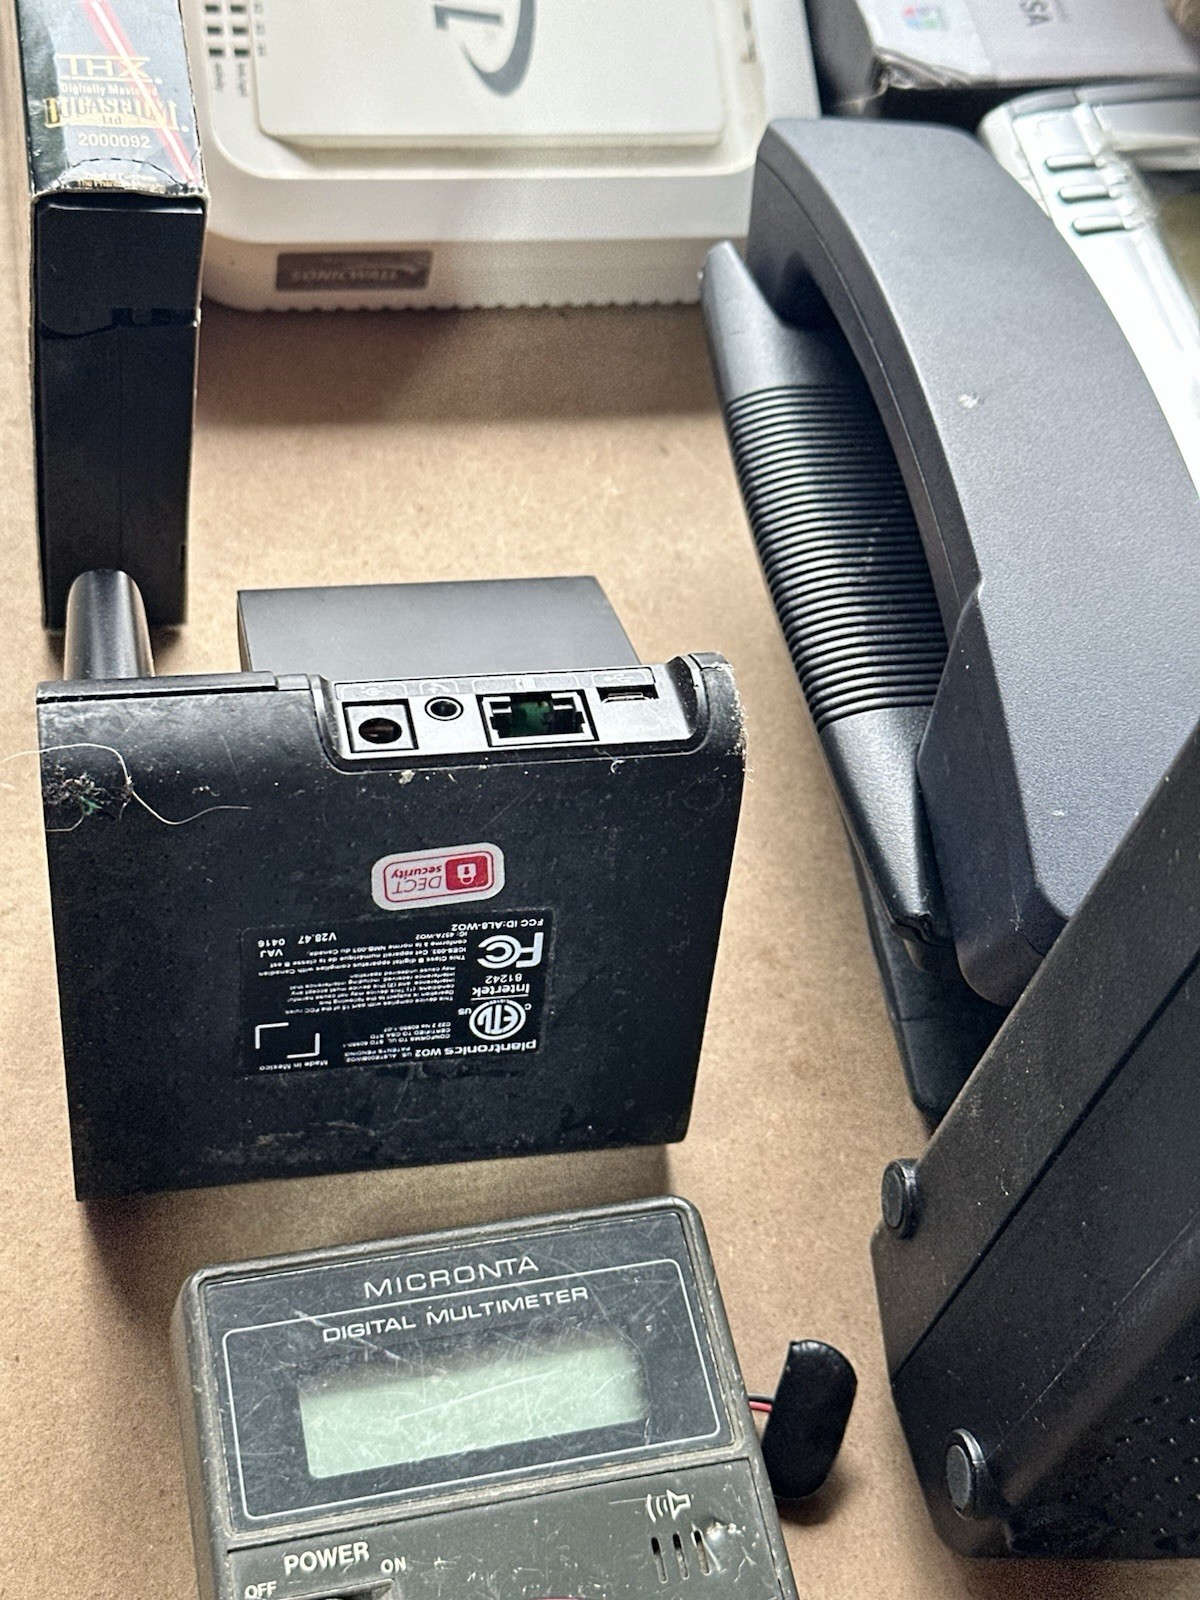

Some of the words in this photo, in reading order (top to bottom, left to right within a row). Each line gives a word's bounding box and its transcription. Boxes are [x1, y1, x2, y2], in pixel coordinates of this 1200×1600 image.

[56, 53, 152, 83] THX
[61, 83, 106, 98] Digitally
[77, 133, 152, 149] 2000092
[390, 866, 442, 880] security
[392, 876, 442, 894] DECT
[520, 918, 544, 927] FCC
[258, 938, 286, 948] 0416
[297, 932, 337, 944] V28.47
[430, 938, 467, 947] conforme
[388, 942, 413, 951] norme
[259, 948, 283, 958] VAJ
[382, 950, 414, 960] appareil
[315, 962, 351, 972] complies
[352, 960, 391, 969] apparatus
[392, 958, 416, 966] digital
[258, 968, 296, 976] Canadian
[484, 972, 522, 984] 81242
[420, 989, 454, 997] Operation
[472, 983, 530, 998] Intertek
[457, 1007, 472, 1016] US
[444, 1039, 537, 1056] plantronics
[304, 1060, 328, 1068] Made
[363, 1255, 539, 1299] MICRONTA
[322, 1315, 417, 1343] DIGITAL
[426, 1286, 589, 1326] MULTIMETER
[283, 1541, 370, 1576] POWER
[380, 1556, 407, 1574] ON
[244, 1581, 277, 1600] OFF
